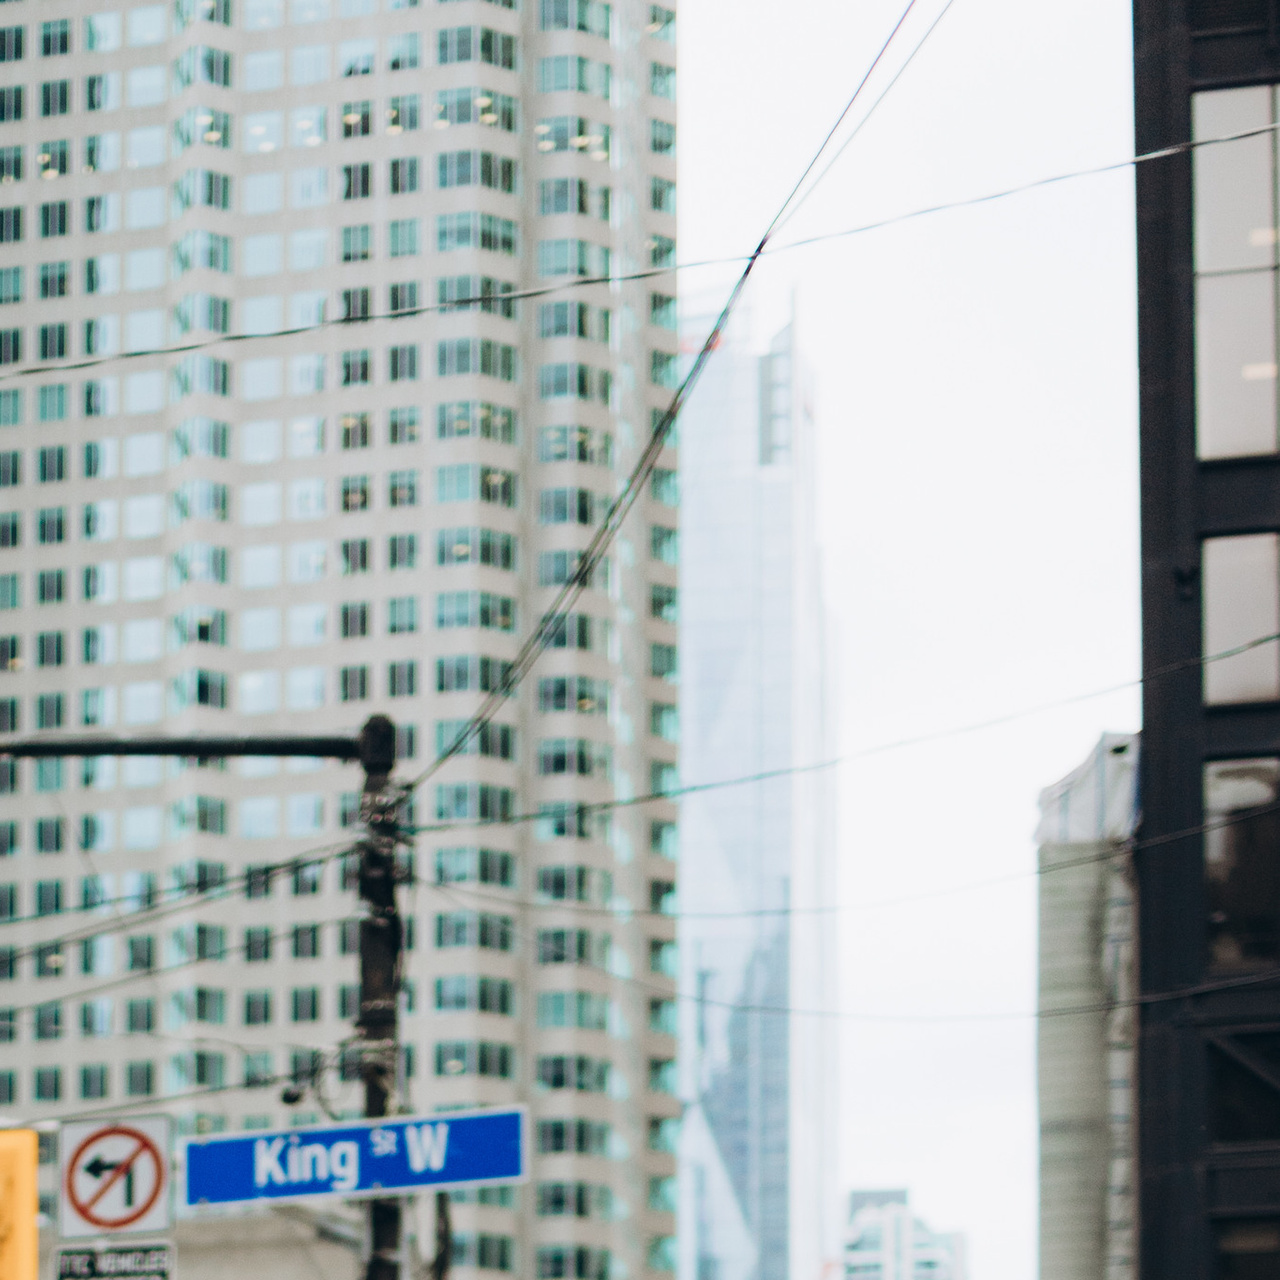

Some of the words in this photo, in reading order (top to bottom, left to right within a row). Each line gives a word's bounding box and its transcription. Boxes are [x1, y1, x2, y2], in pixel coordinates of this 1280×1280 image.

[254, 1136, 359, 1192] King
[370, 1129, 397, 1156] St
[406, 1122, 449, 1173] W
